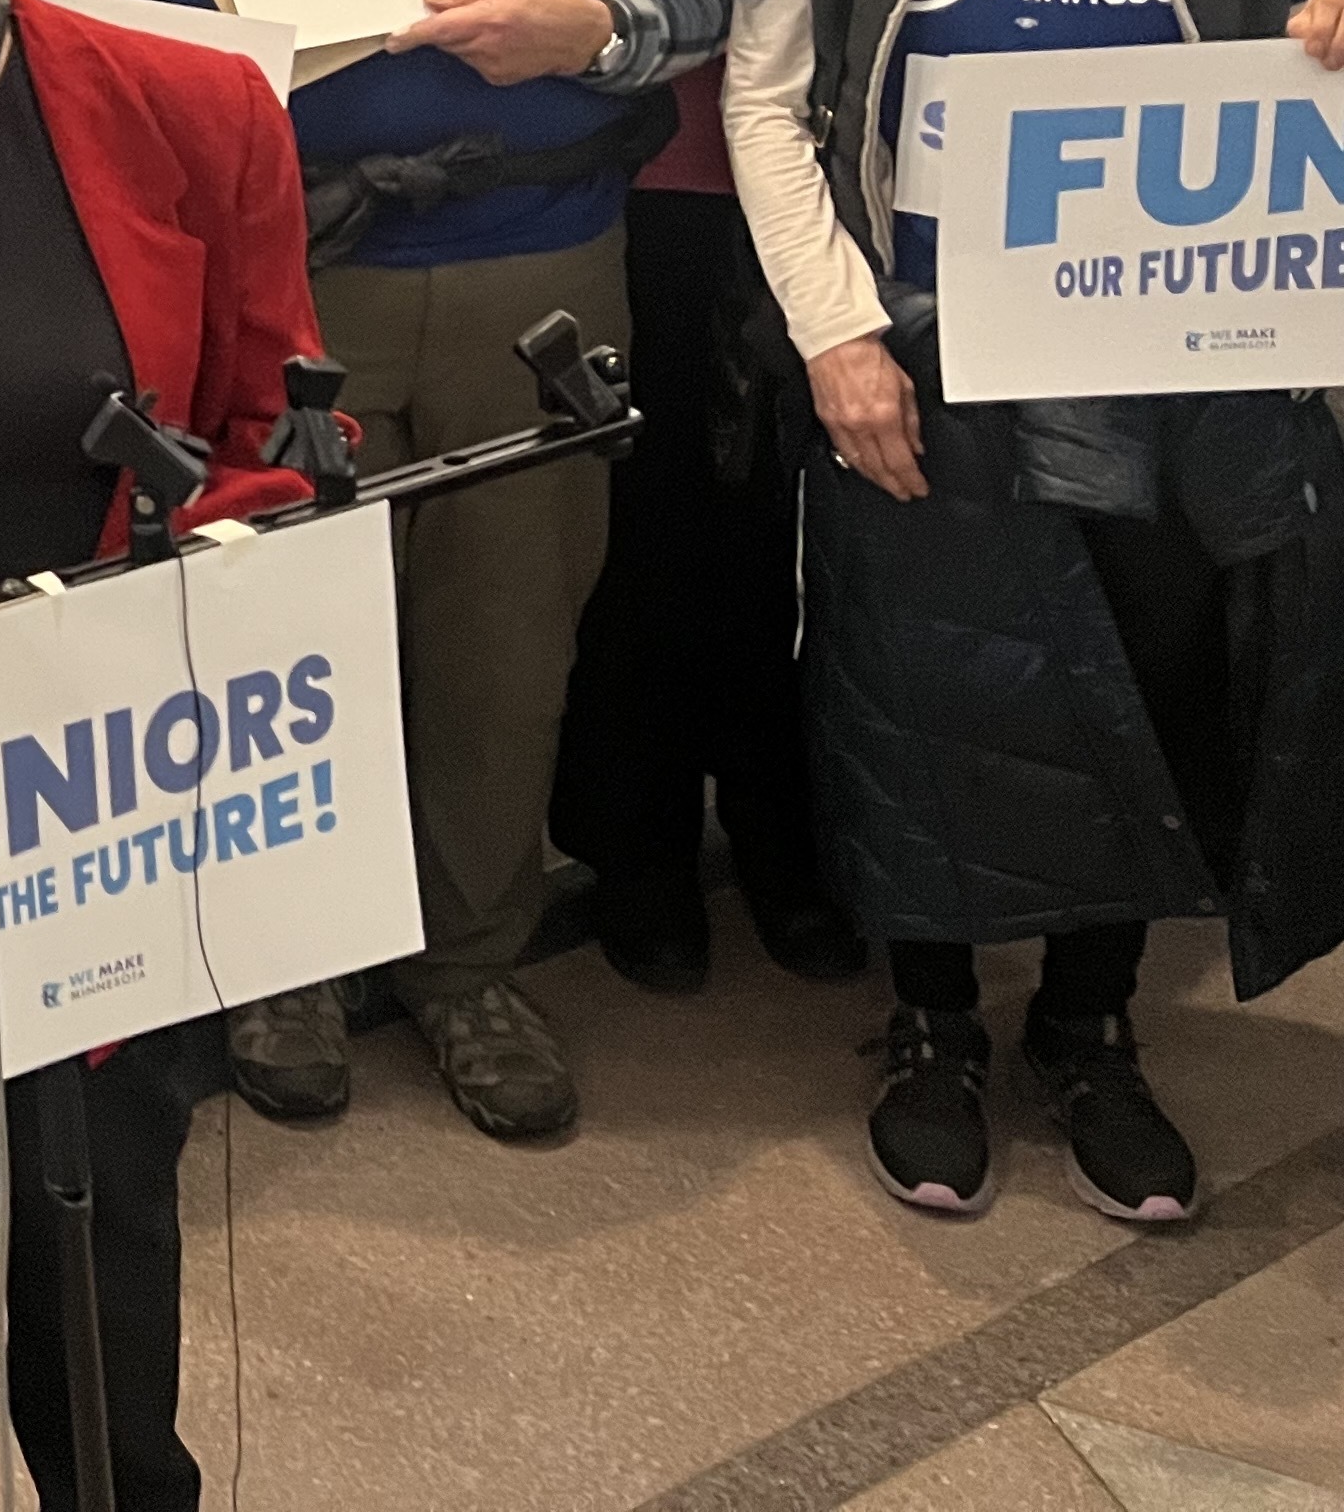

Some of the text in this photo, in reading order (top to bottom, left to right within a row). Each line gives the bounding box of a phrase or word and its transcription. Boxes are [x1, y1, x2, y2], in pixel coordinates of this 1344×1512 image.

[1004, 99, 1344, 250] FUN
[1055, 227, 1344, 298] OUR FUTURE
[73, 759, 338, 906] FUTURE!
[99, 953, 144, 979] MAKE
